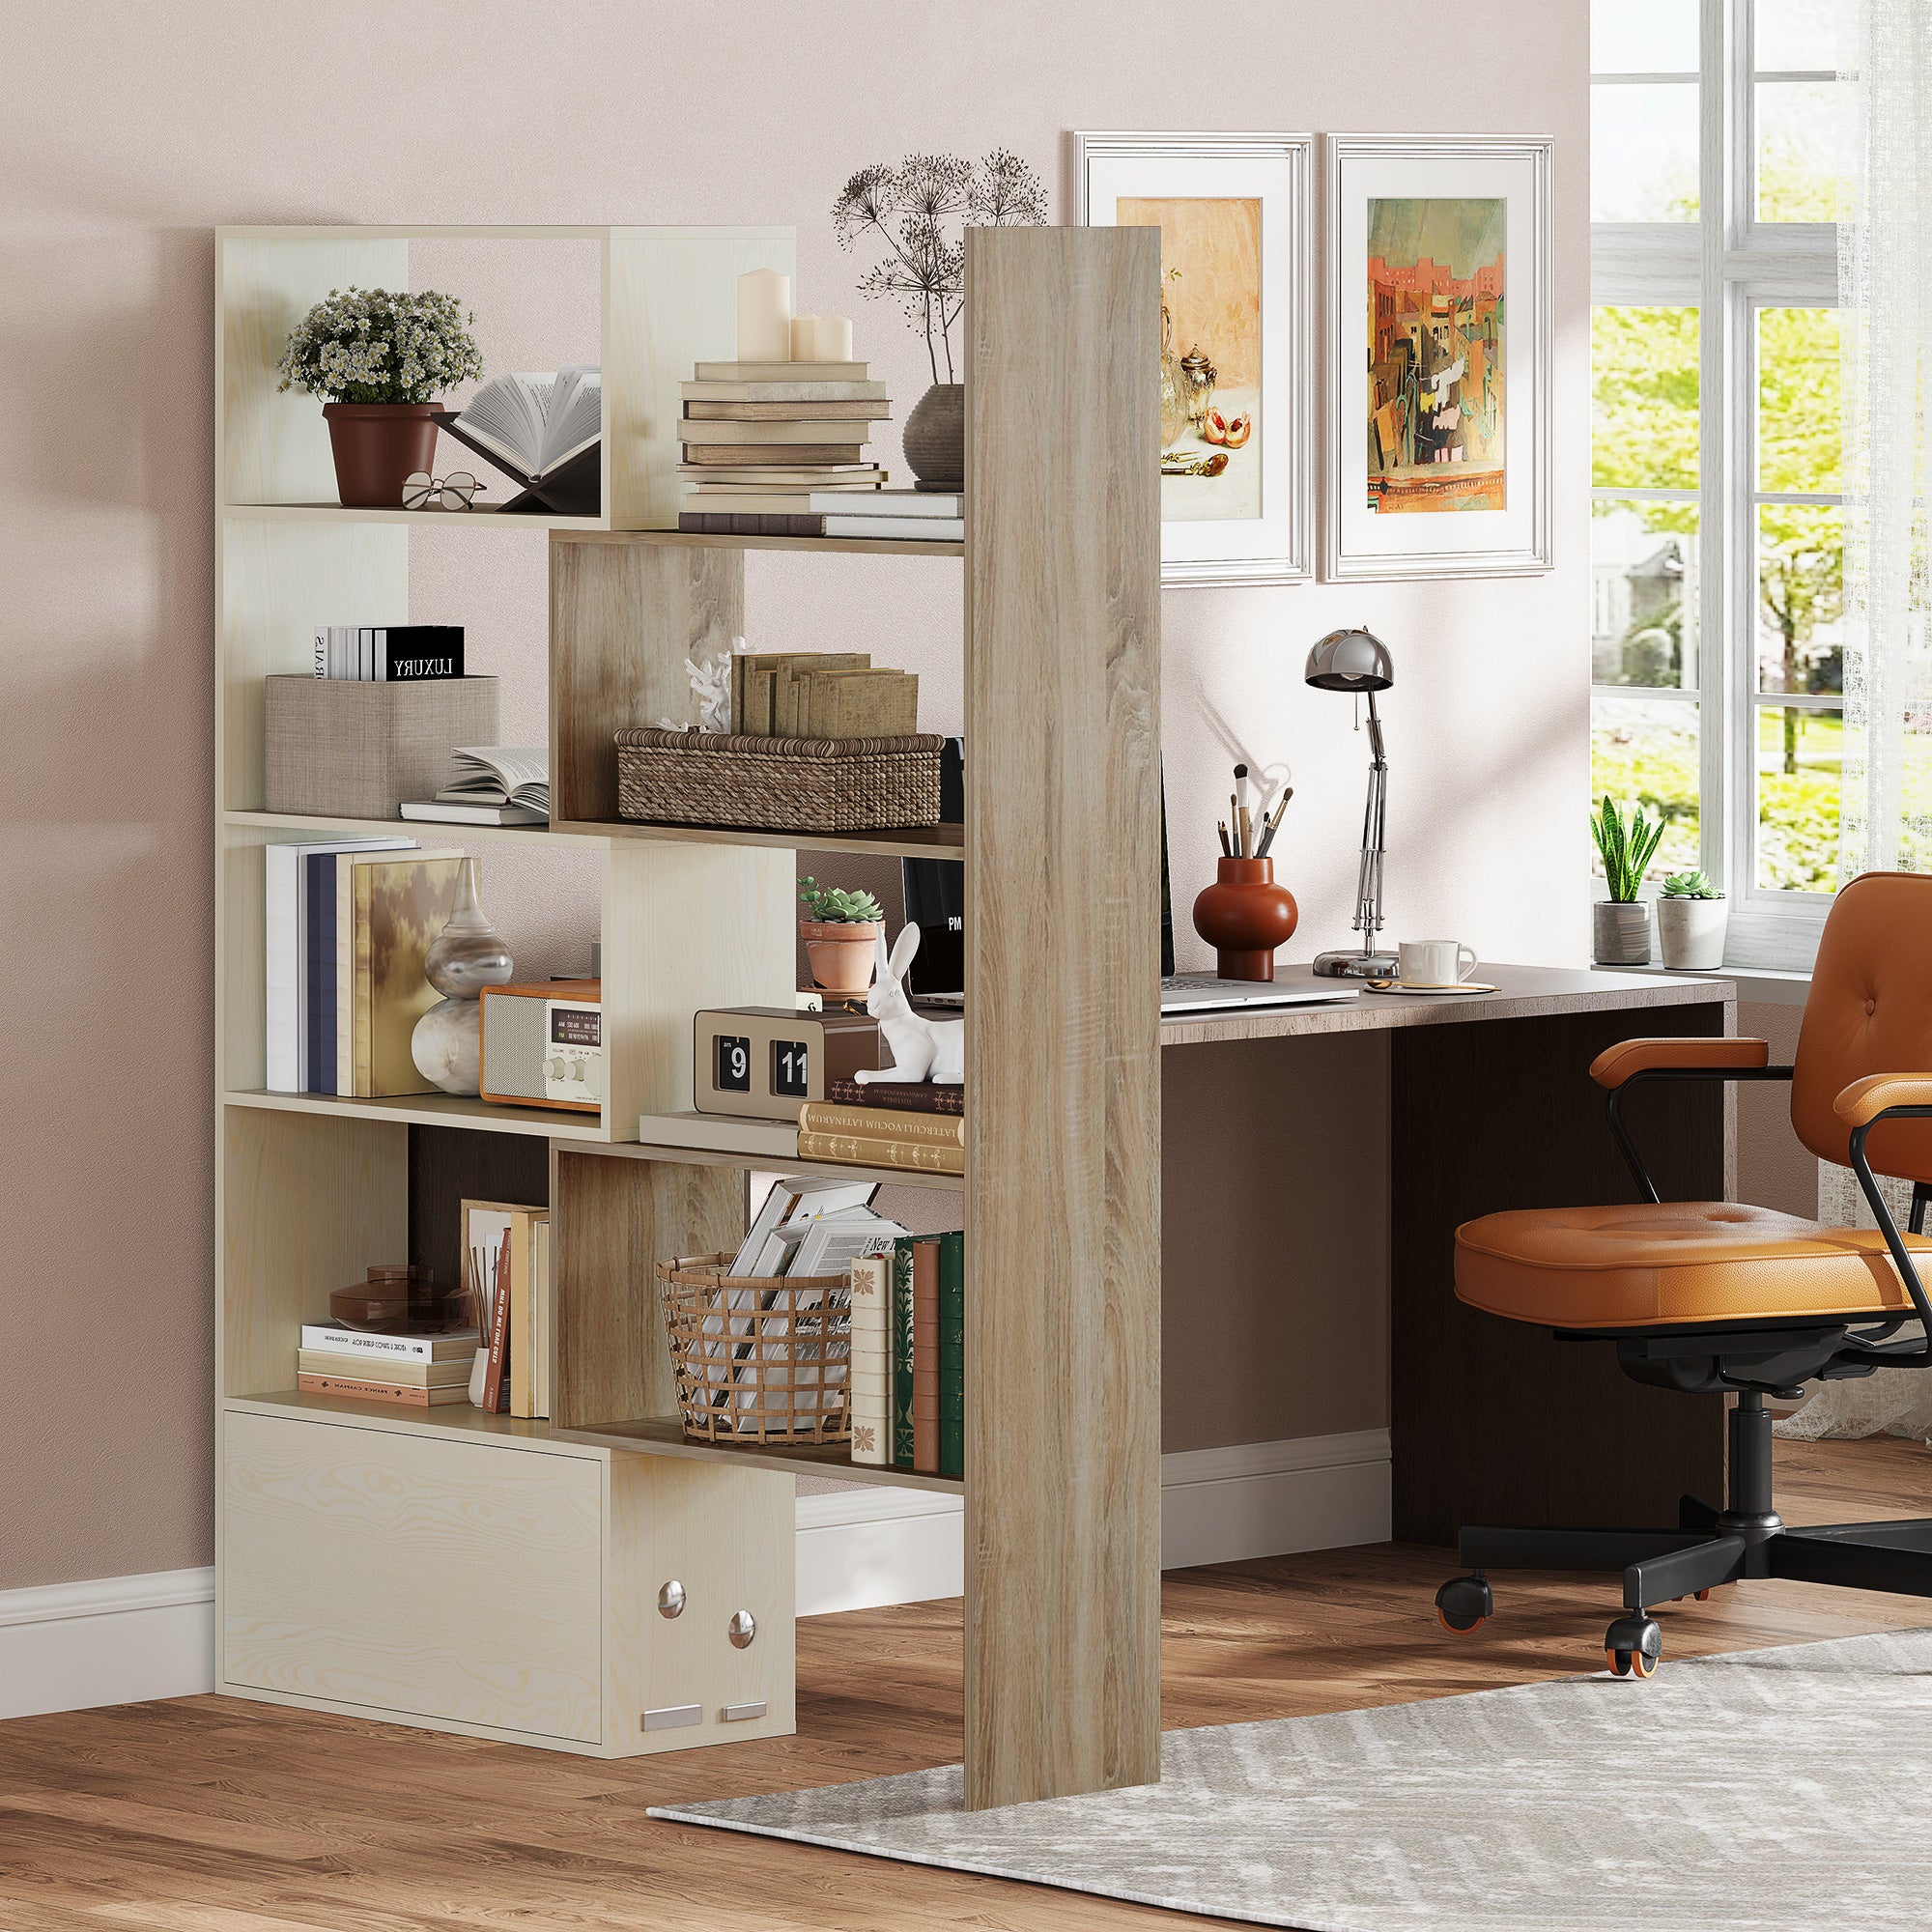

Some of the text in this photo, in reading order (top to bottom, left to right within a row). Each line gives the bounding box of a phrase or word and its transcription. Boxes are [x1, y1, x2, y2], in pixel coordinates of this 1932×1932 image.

[948, 916, 962, 931] PM
[731, 1047, 808, 1084] 9 11
[808, 1113, 956, 1138] LATERCULI VOCUM LATINARUM
[870, 1237, 890, 1251] New
